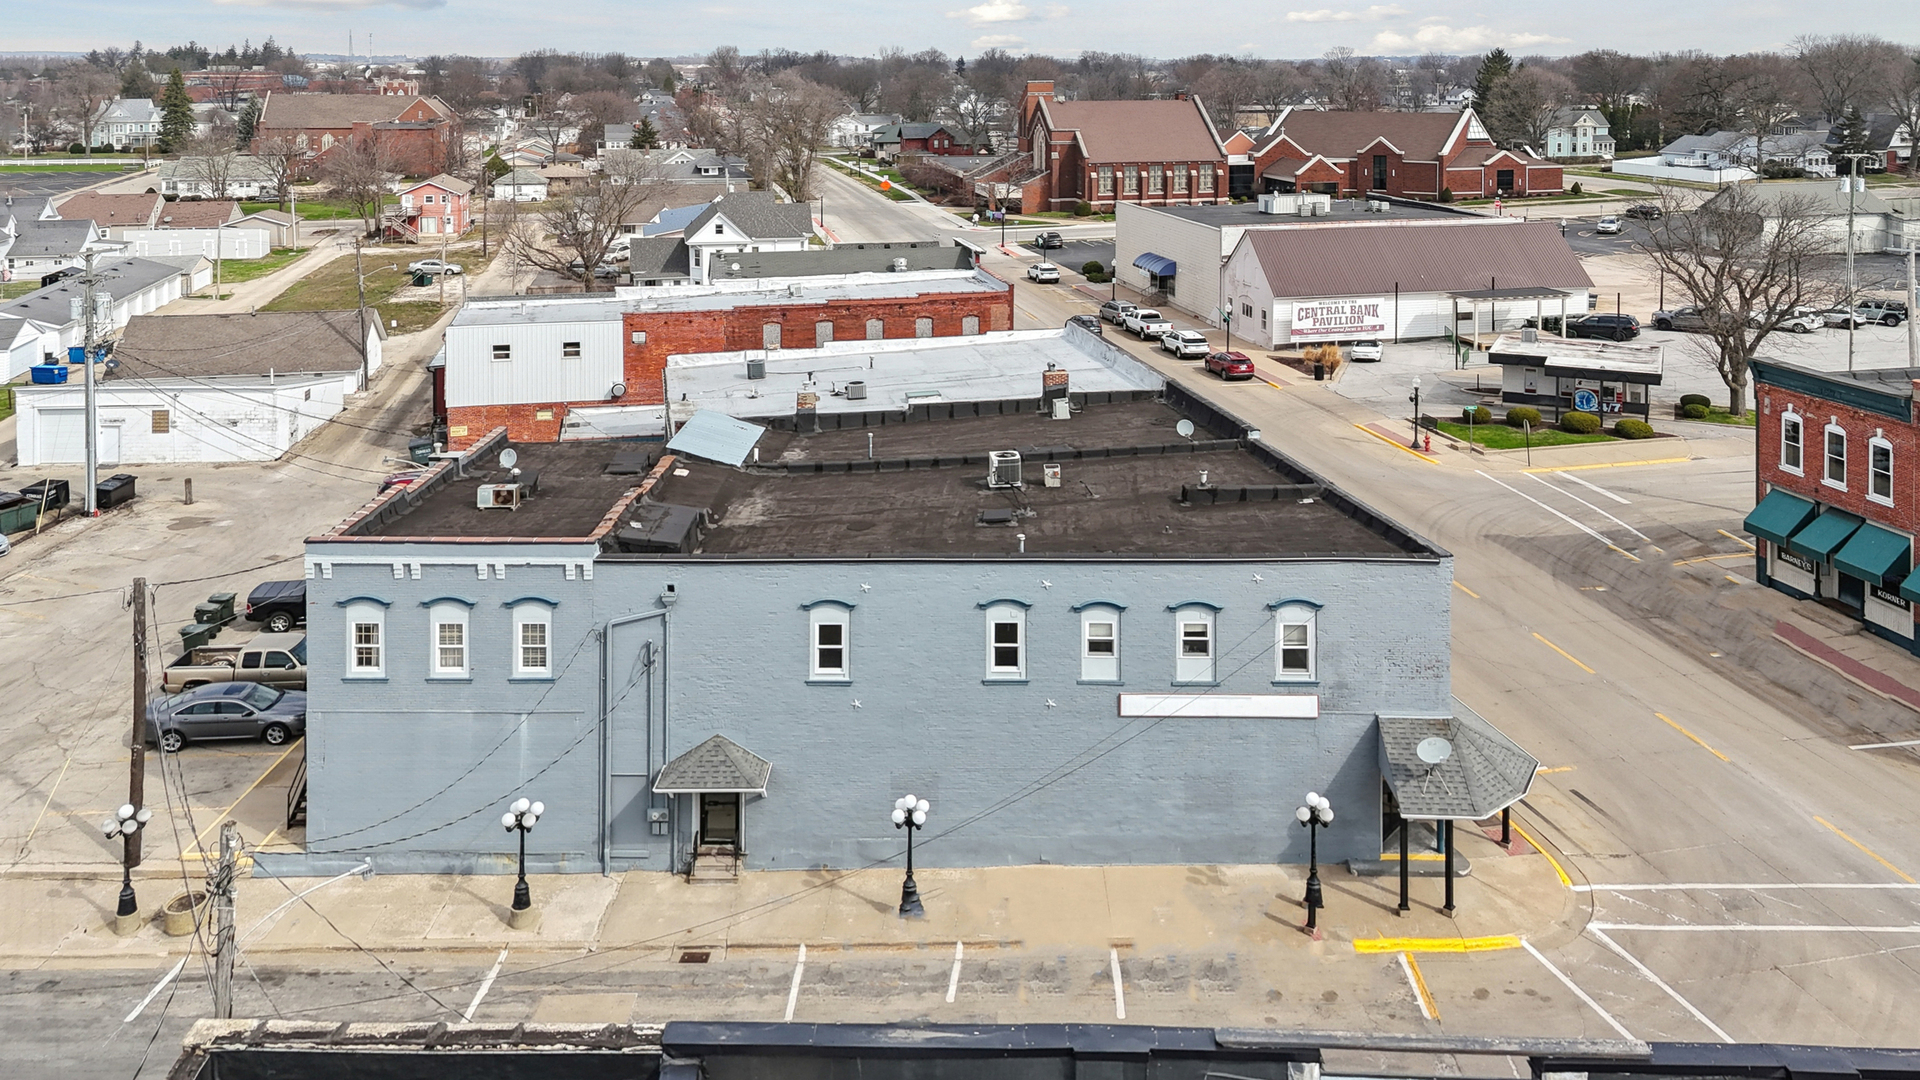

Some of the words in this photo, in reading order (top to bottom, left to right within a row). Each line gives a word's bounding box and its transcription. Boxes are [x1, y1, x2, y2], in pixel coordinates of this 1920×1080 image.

[1297, 306, 1347, 321] CENTRAL
[1350, 304, 1379, 318] BANK
[1312, 315, 1364, 327] PAVILION
[1877, 589, 1906, 607] KORNER
